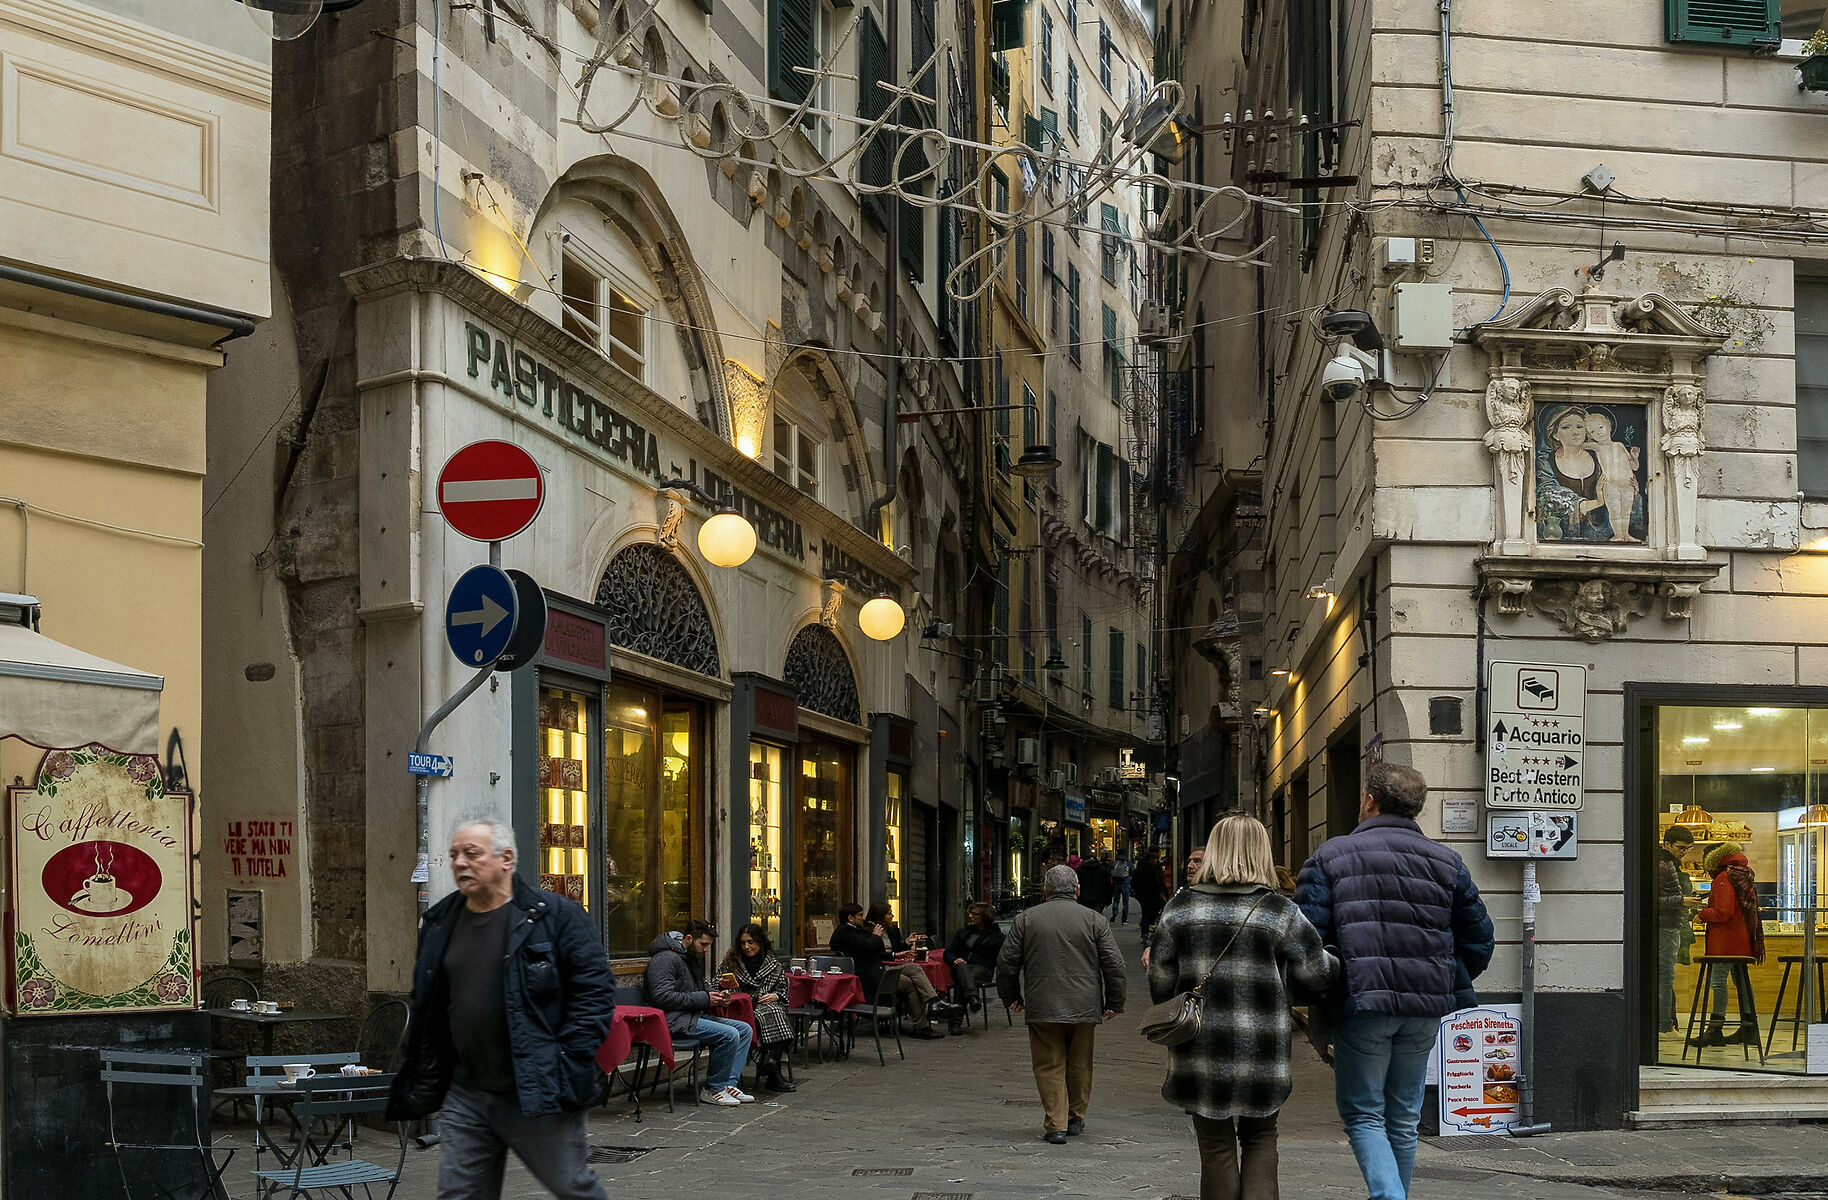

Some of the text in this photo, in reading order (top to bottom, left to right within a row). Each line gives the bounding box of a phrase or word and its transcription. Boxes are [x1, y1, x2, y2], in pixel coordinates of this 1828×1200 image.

[465, 321, 661, 480] PASTICCERIA
[1509, 726, 1582, 746] Acquario
[409, 754, 438, 774] TOUR 4
[1490, 767, 1580, 787] Best Western
[1533, 787, 1577, 805] Antico
[22, 802, 177, 848] Caffetteria
[228, 821, 292, 837] LO STATO TI
[224, 839, 291, 855] VEDE MA NON
[232, 857, 286, 877] TI TUTELA
[41, 913, 164, 947] Lomellini
[1450, 1017, 1514, 1031] Pescheria Sirenetta
